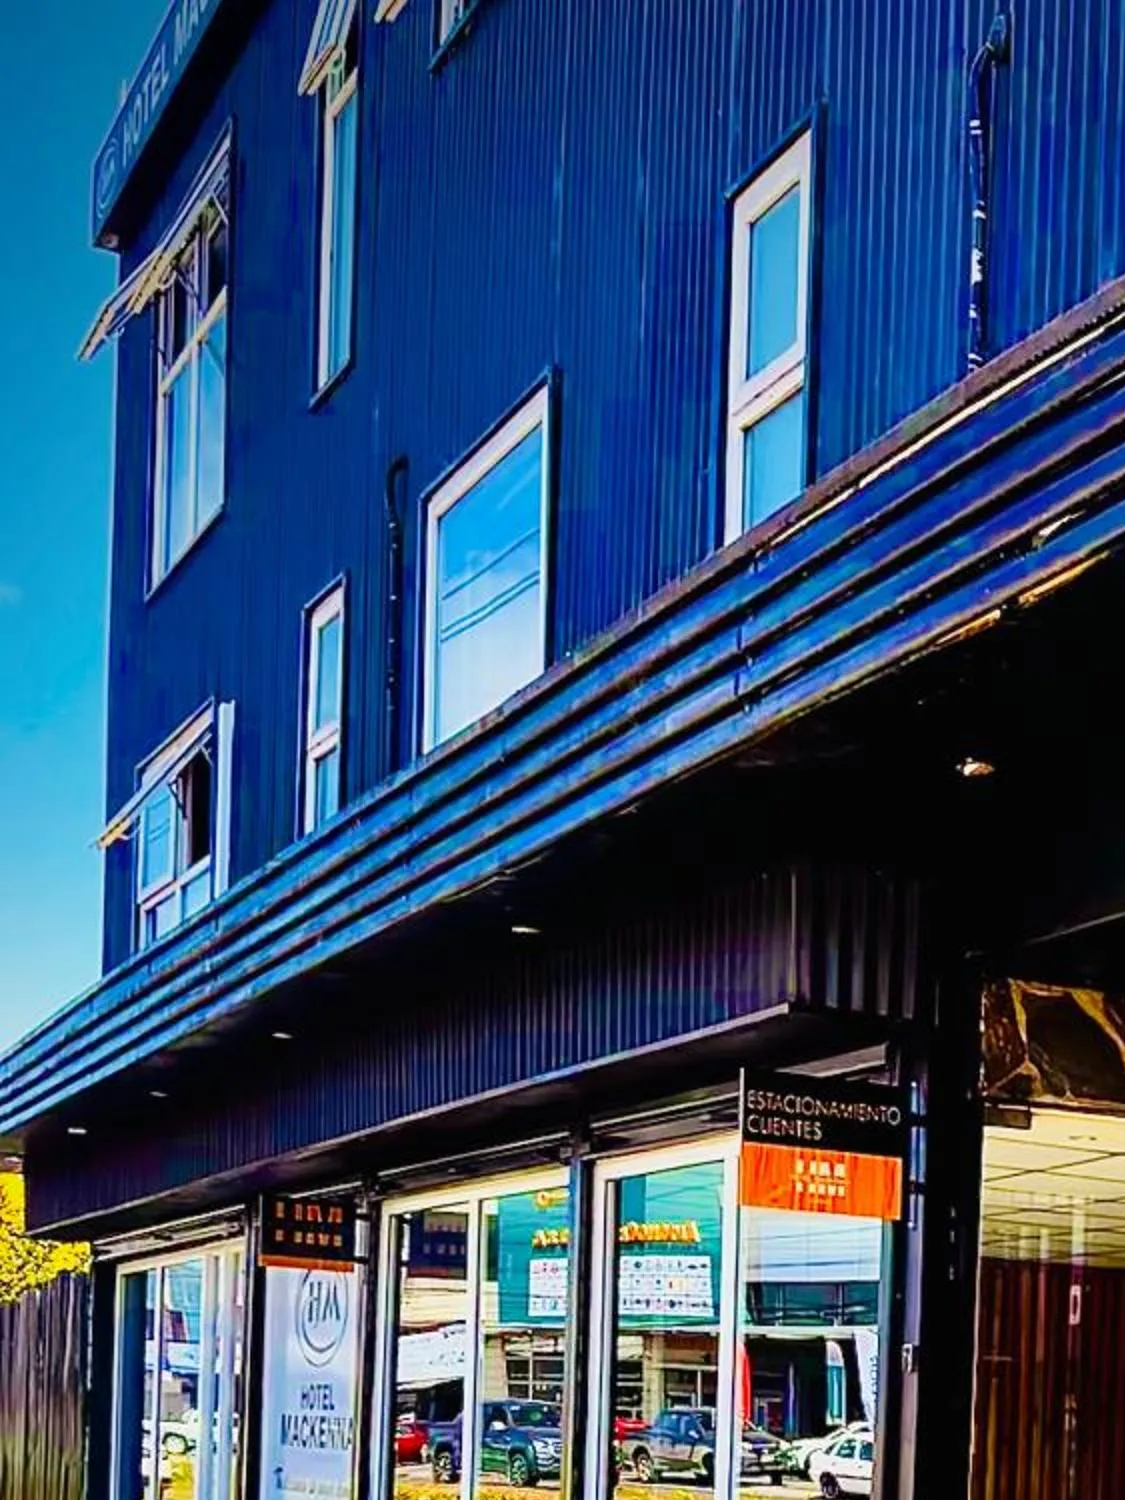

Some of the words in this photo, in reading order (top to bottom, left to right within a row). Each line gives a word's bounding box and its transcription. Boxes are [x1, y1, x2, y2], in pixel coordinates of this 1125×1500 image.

[746, 1089, 901, 1126] ESTACIONAMIENTO
[299, 1385, 335, 1412] HOTEL
[280, 1412, 354, 1450] MACKENNA
